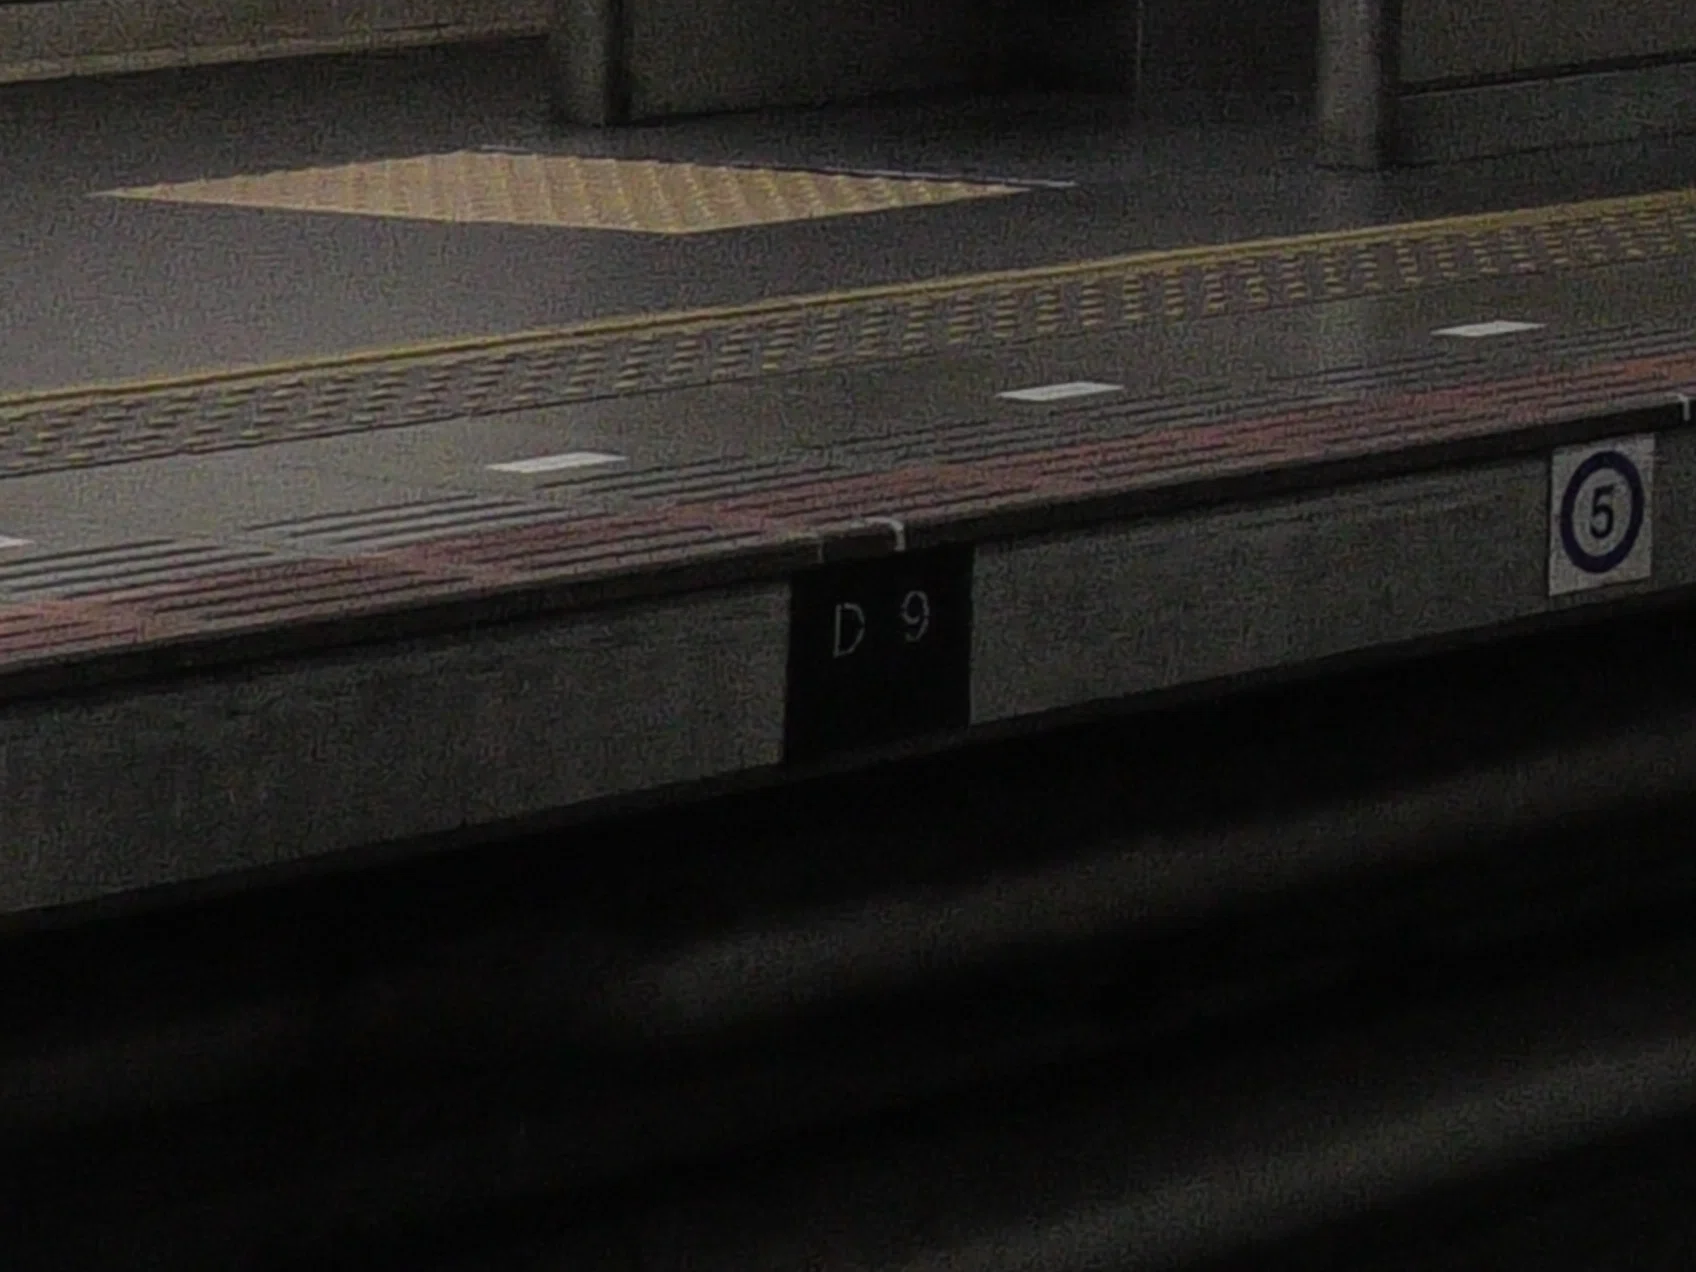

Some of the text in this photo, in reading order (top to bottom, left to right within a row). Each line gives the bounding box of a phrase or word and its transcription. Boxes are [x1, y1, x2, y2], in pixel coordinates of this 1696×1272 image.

[1589, 481, 1615, 540] 5
[833, 590, 931, 658] D 9
